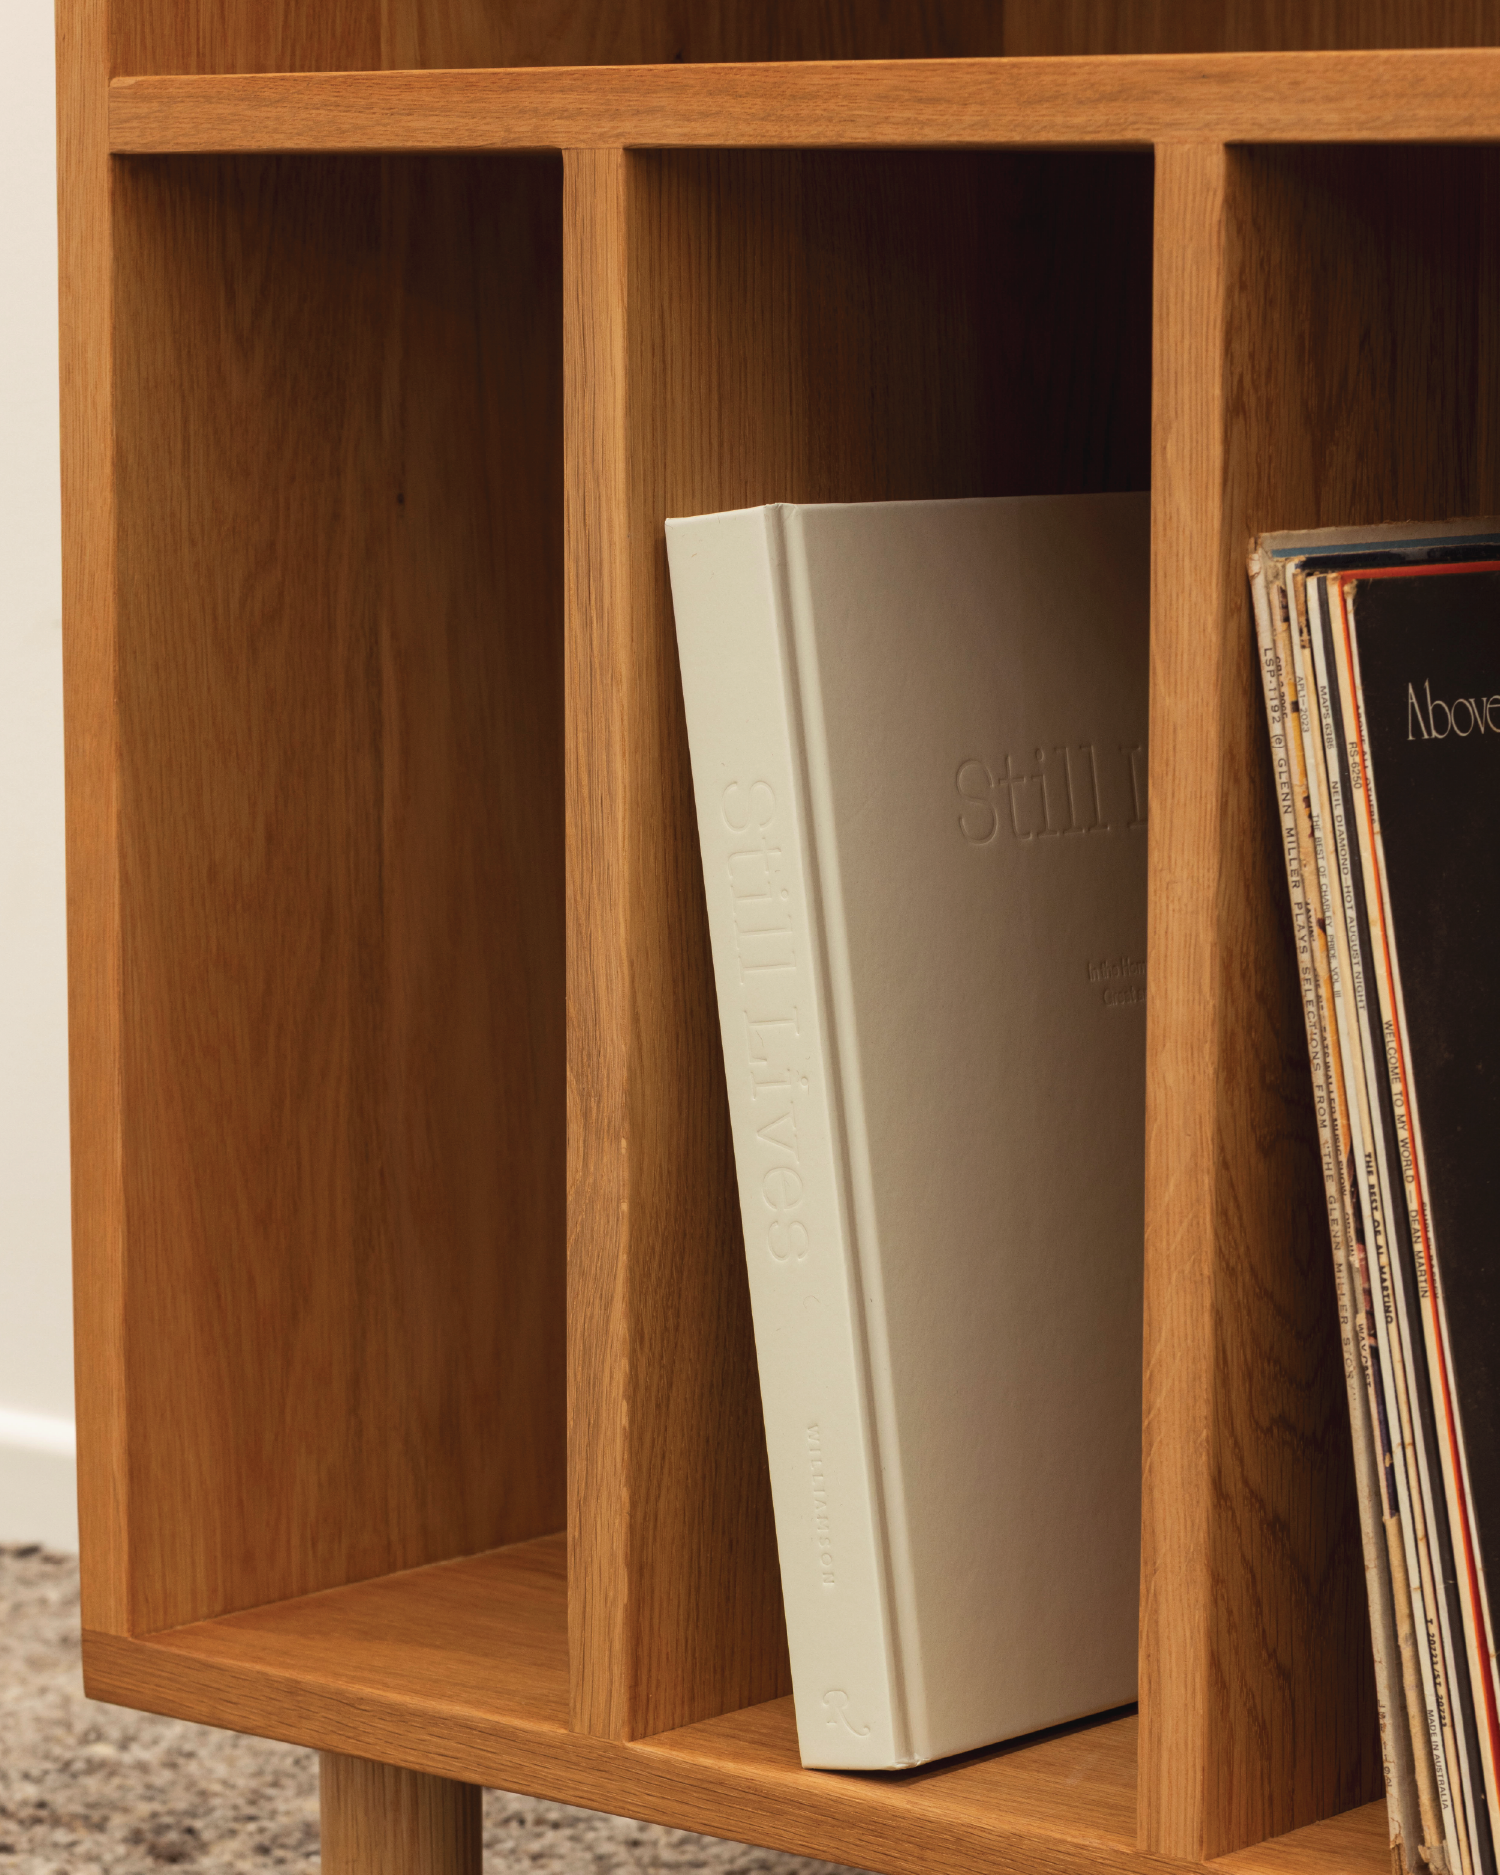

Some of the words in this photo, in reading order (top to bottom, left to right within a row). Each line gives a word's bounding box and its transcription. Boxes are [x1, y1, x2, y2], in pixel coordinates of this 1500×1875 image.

[1320, 684, 1331, 719] MAPS
[1407, 678, 1500, 740] Above
[1349, 741, 1362, 789] RS-6250
[956, 744, 1111, 846] Still
[1311, 812, 1321, 832] THE
[1314, 836, 1325, 861] BEST
[1318, 865, 1327, 879] OF
[722, 780, 797, 986] Still
[1321, 882, 1333, 928] CHARLEY
[1332, 780, 1342, 813] NEIL
[1348, 915, 1360, 967] AUGUST
[1355, 970, 1366, 1011] NIGHT
[1264, 647, 1281, 724] LSP-1192
[1278, 758, 1292, 814] GLENN
[1286, 827, 1301, 889] MILLER
[1295, 901, 1308, 954] PLAYS
[1302, 966, 1321, 1072] SELECTIONS
[1316, 1084, 1328, 1129] FROM
[1328, 1194, 1342, 1250] GLENN
[1336, 1262, 1350, 1324] MILLER
[1384, 1019, 1400, 1084] WELCOME
[1392, 1089, 1404, 1108] TO
[1396, 1113, 1407, 1131] MY
[744, 1006, 810, 1262] Lives
[1400, 1136, 1414, 1184] WORLD
[1364, 1151, 1374, 1176] THE
[1369, 1183, 1379, 1212] BEST
[1379, 1264, 1394, 1325] MARTINO
[1410, 1209, 1422, 1245] DEAN
[1415, 1249, 1429, 1298] MARTIN
[806, 1423, 835, 1586] WILLIAMSON
[1428, 1709, 1438, 1738] MADE
[1431, 1740, 1440, 1751] IN
[1433, 1753, 1449, 1810] AUSTRALIA
